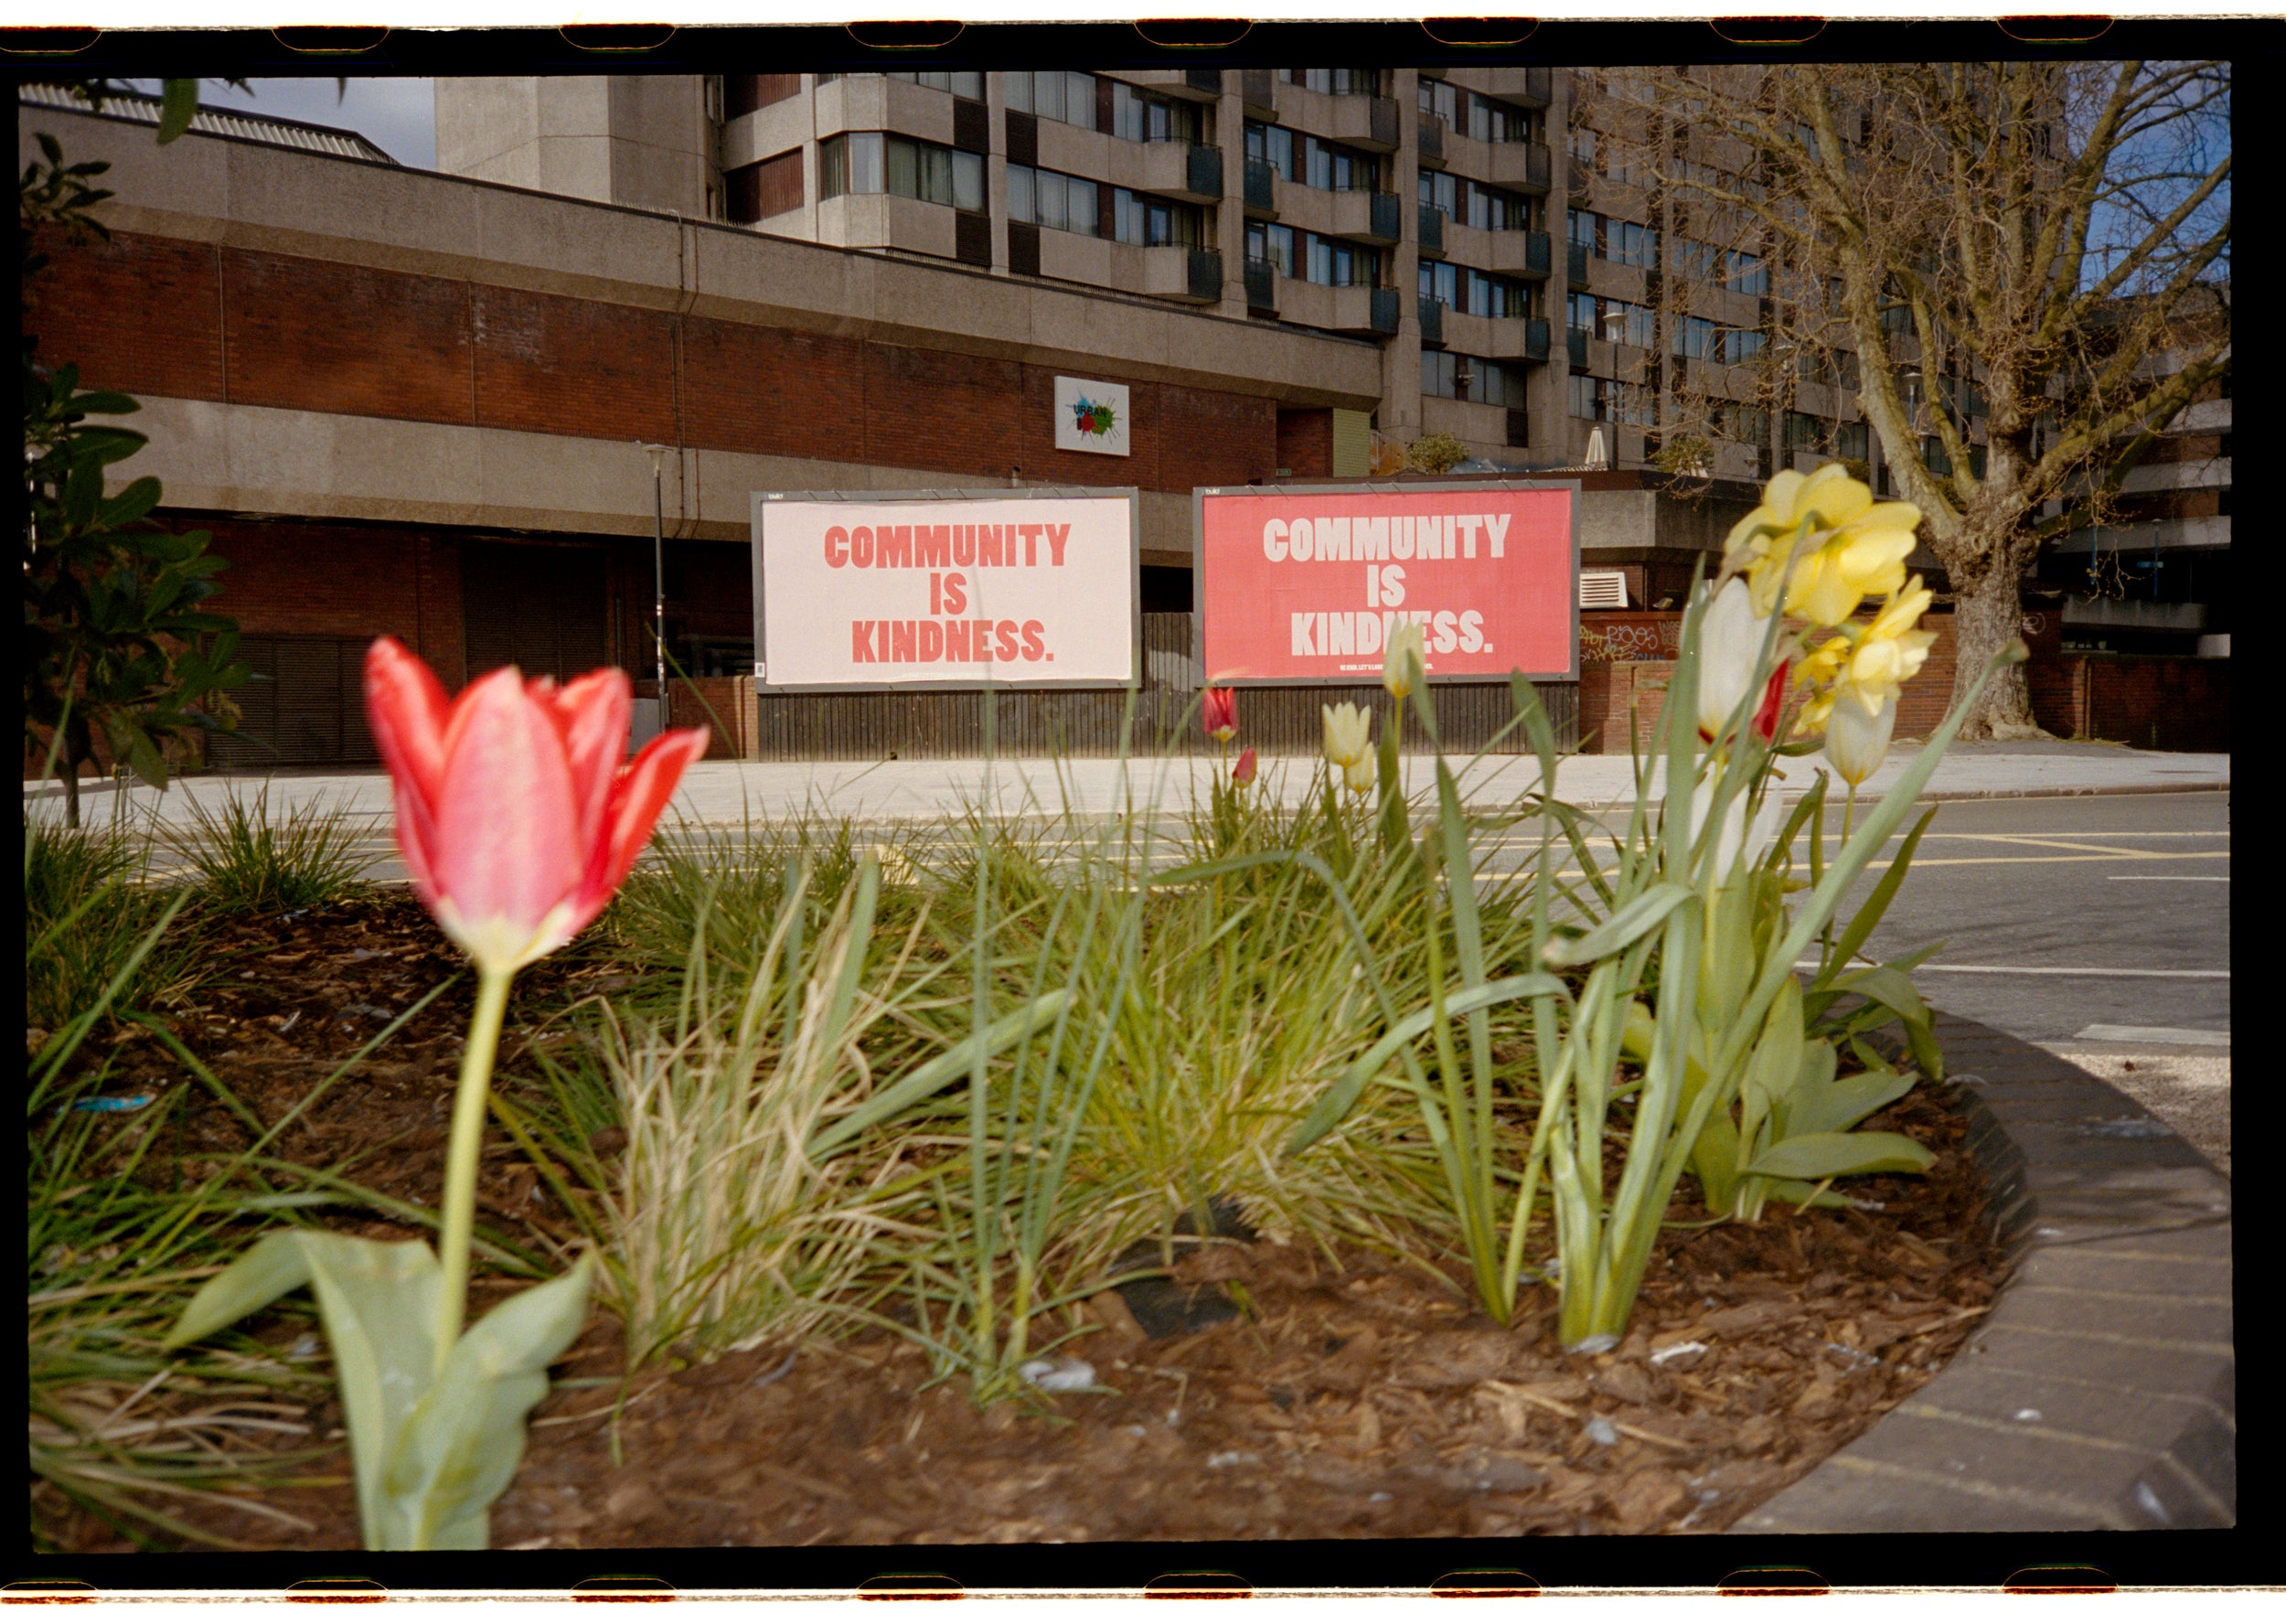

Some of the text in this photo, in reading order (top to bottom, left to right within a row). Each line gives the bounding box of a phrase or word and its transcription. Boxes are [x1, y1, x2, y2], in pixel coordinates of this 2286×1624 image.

[1074, 404, 1107, 418] URBAN
[825, 524, 1071, 569] COMMUNITY
[1264, 514, 1511, 561] COMMUNITY
[930, 572, 967, 615] IS
[1367, 564, 1405, 607] IS
[852, 620, 1054, 663] KINDNESS.
